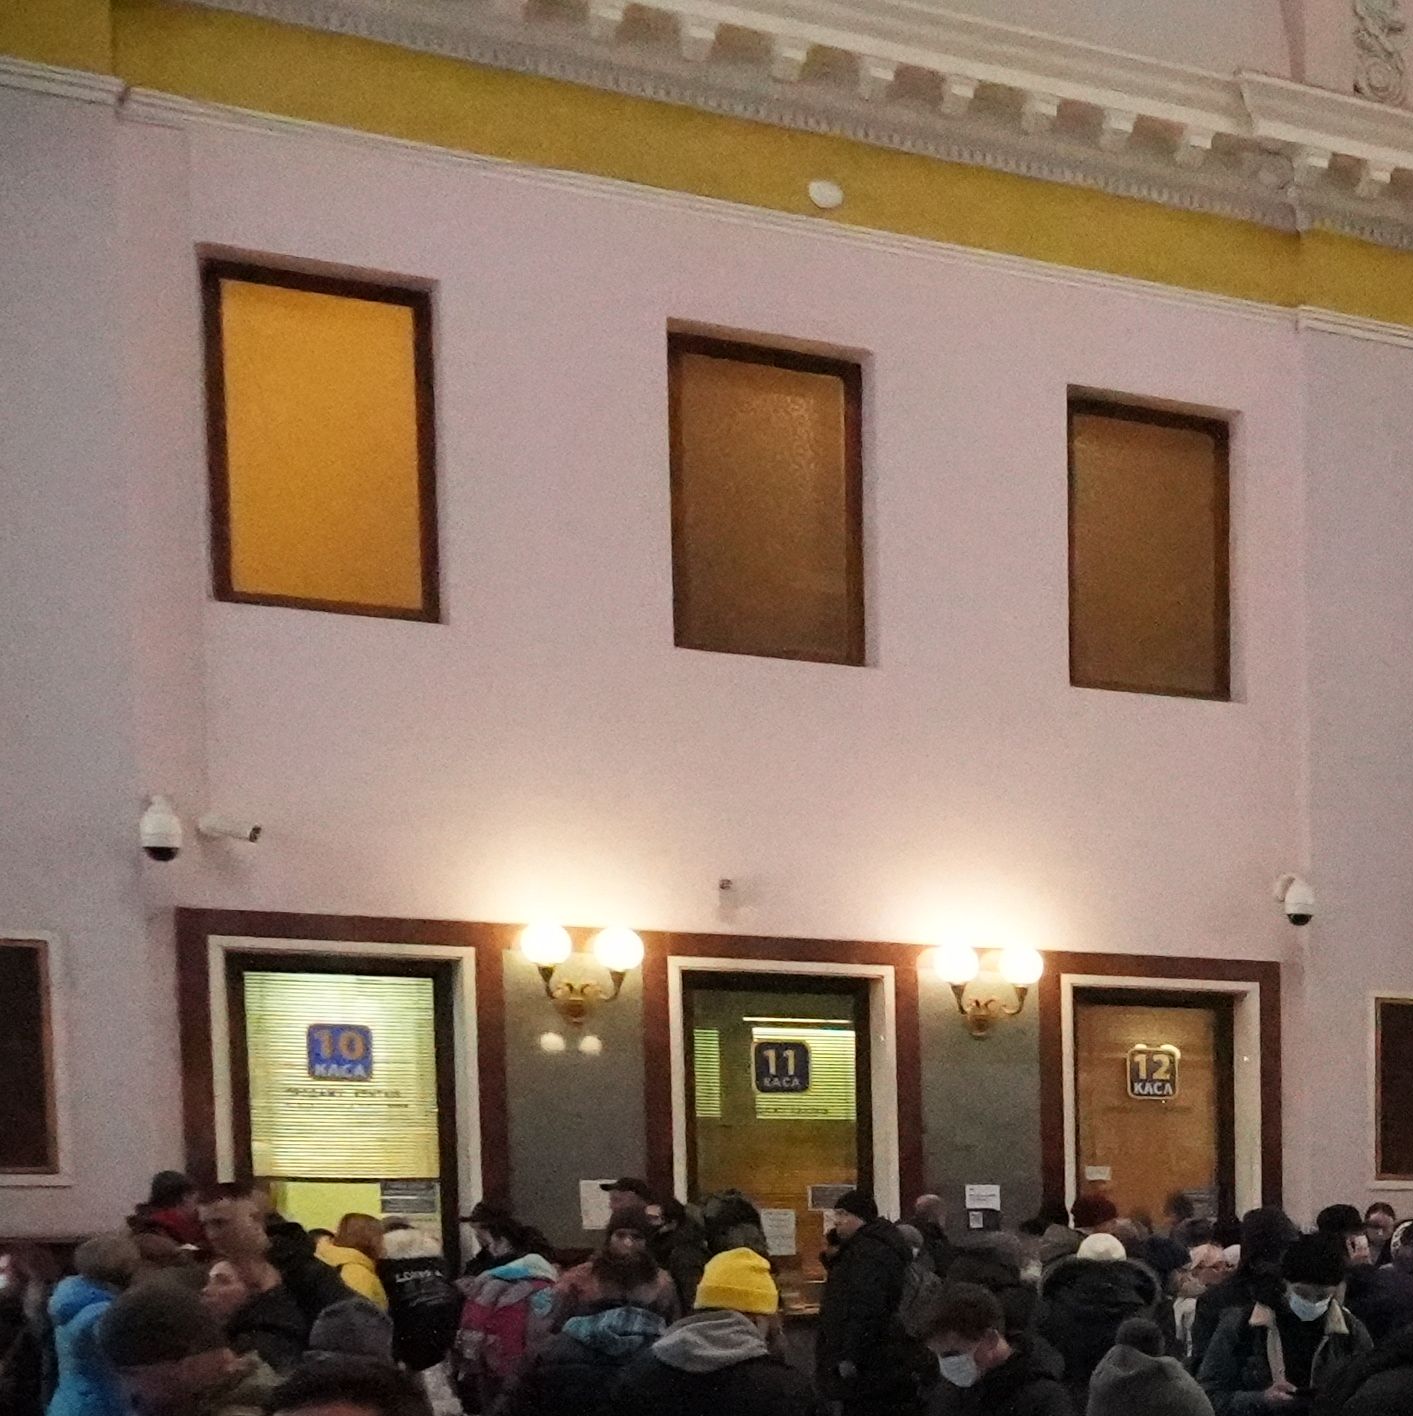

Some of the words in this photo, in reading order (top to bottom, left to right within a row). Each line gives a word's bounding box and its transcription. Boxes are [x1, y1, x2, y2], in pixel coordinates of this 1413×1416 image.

[314, 1028, 366, 1061] 10
[763, 1048, 797, 1076] 11
[1133, 1053, 1171, 1080] 12
[763, 1076, 801, 1088] КАСА
[1133, 1081, 1173, 1095] КАСА
